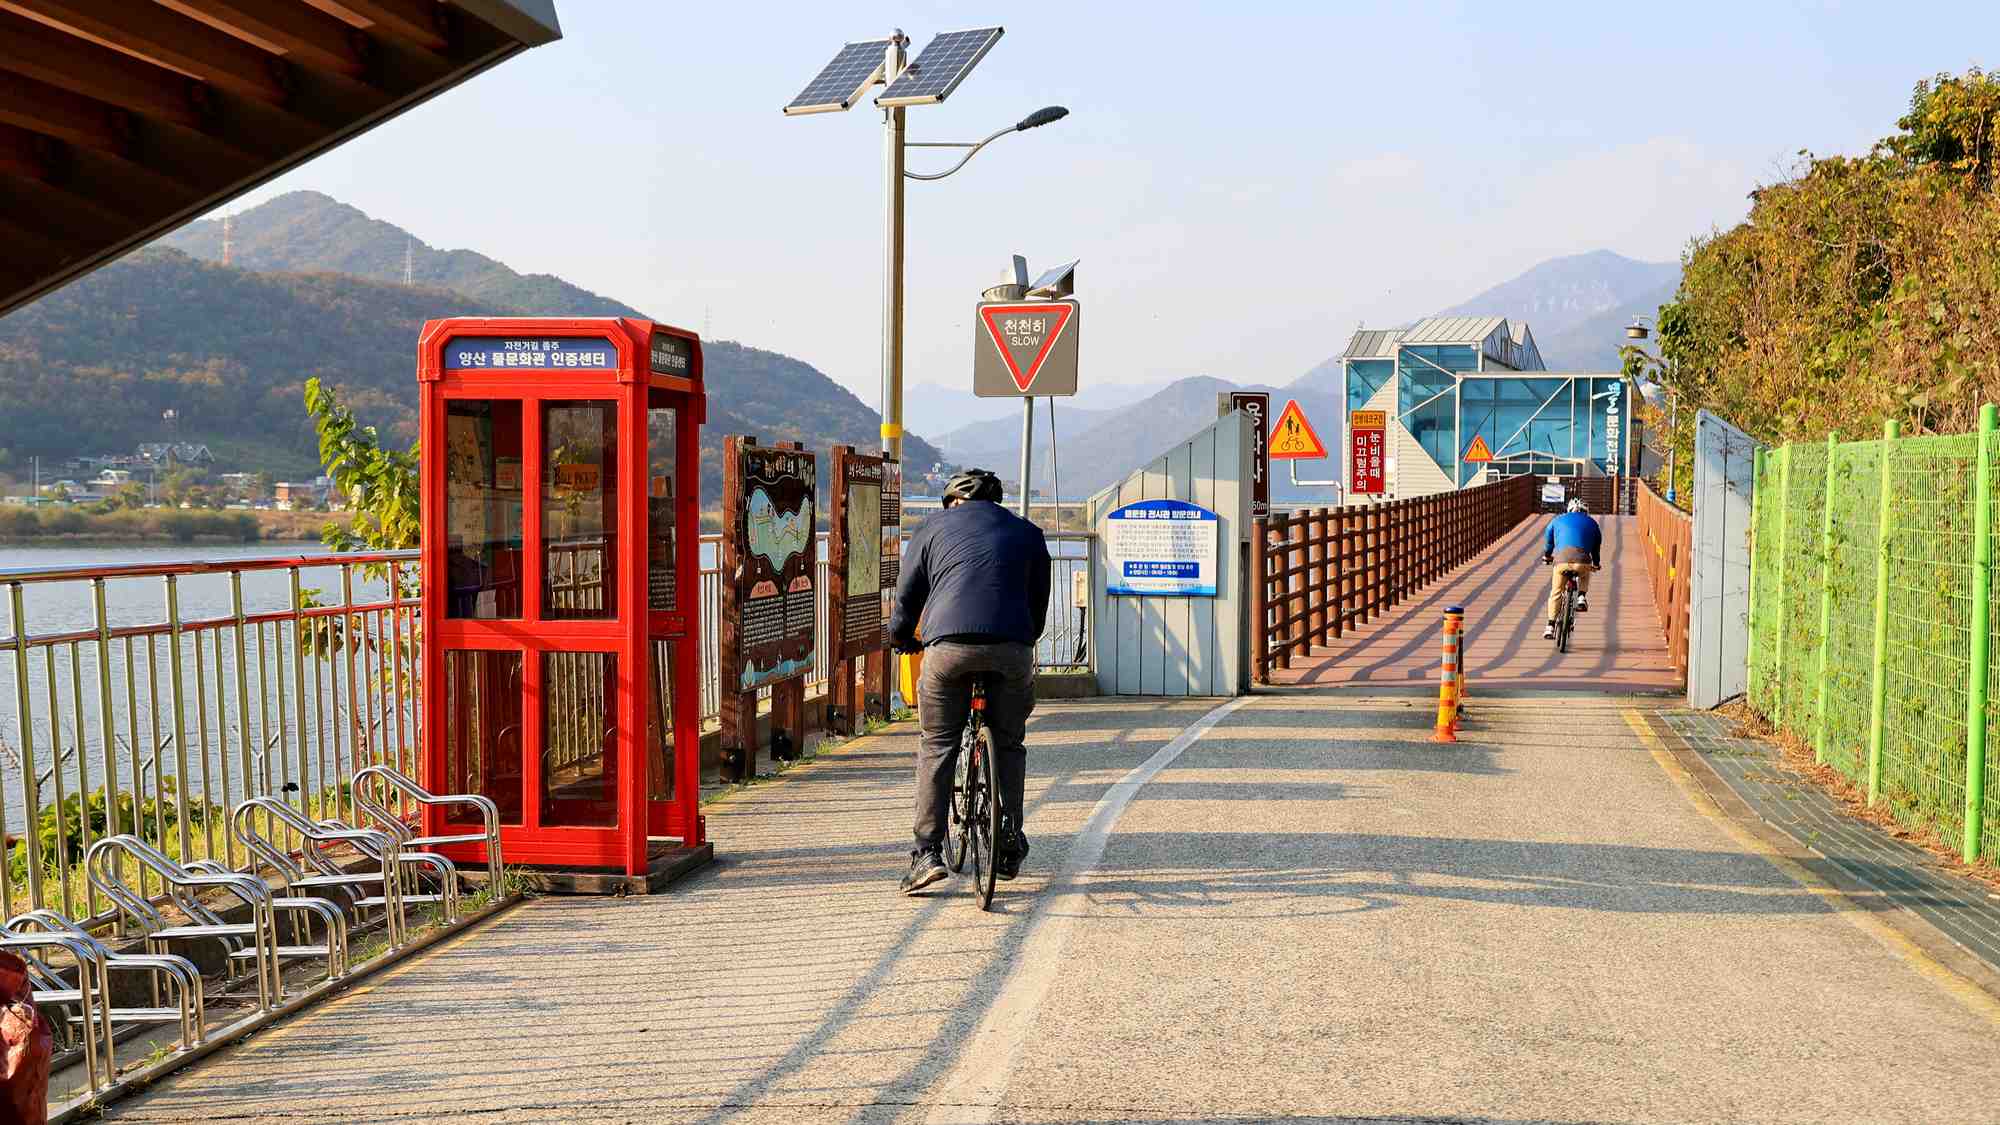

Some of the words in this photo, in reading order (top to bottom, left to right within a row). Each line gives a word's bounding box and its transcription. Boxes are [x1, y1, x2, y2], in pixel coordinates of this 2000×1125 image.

[1004, 318, 1046, 335] 천천히
[504, 341, 538, 351] 자전거길
[1011, 336, 1040, 346] SLOW
[459, 352, 485, 366] 양산
[492, 352, 545, 366] 물문화관
[551, 352, 605, 366] 인증센터
[1356, 435, 1368, 491] 미끄럼주의
